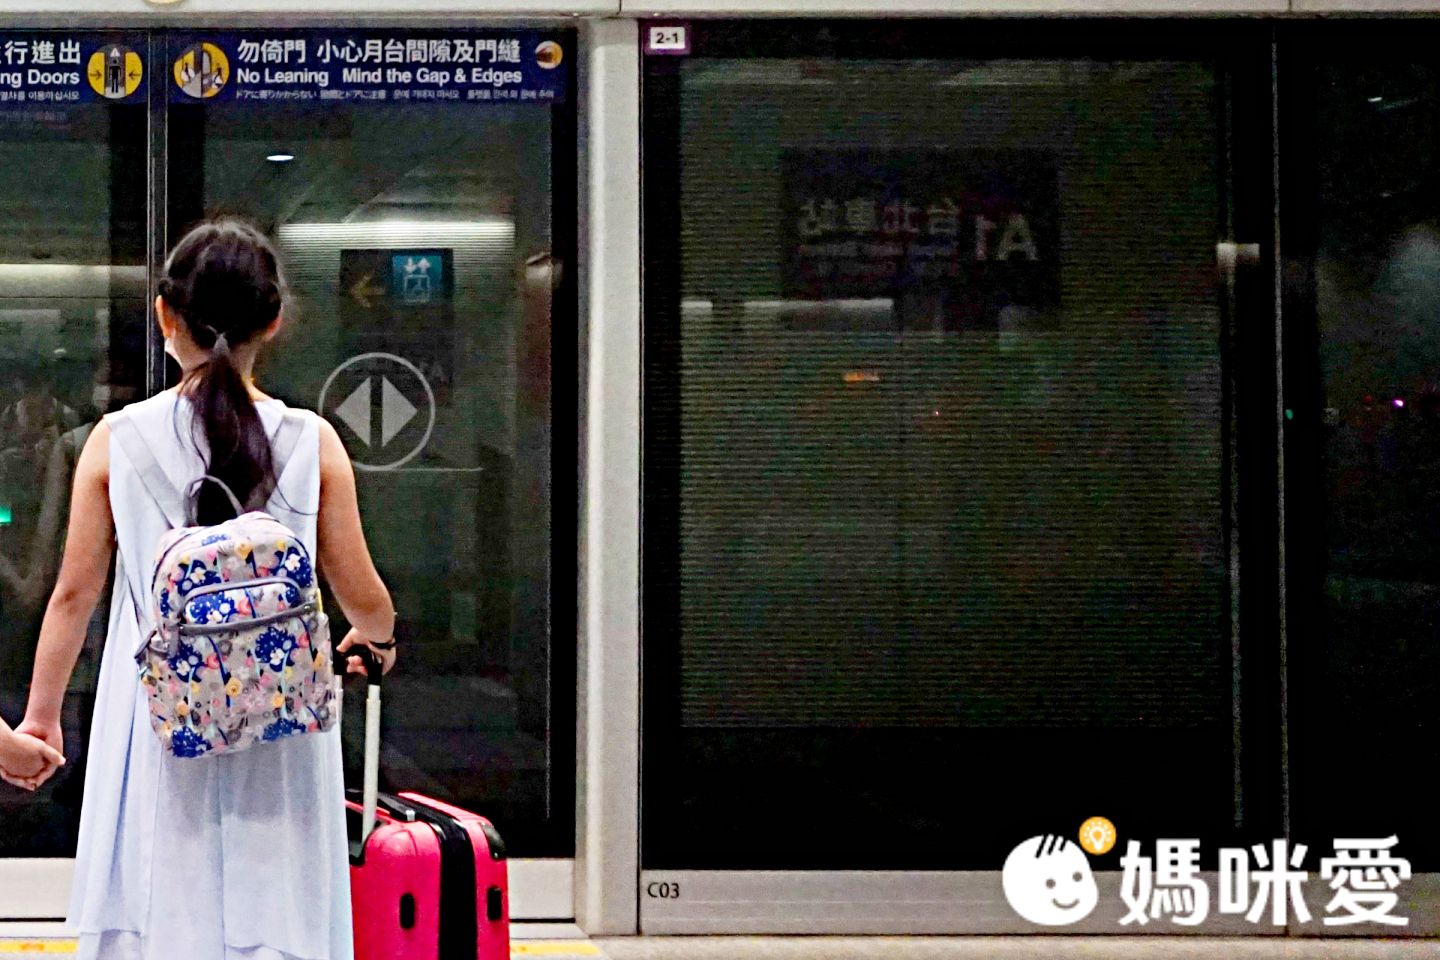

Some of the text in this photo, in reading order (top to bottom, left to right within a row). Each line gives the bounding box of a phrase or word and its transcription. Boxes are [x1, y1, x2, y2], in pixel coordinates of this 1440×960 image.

[655, 31, 680, 45] 2-1
[236, 38, 307, 64] 勿倚門
[26, 68, 81, 86] Doors
[236, 67, 523, 88] No Leaning Mind the Gap & Edges
[646, 881, 681, 900] C03
